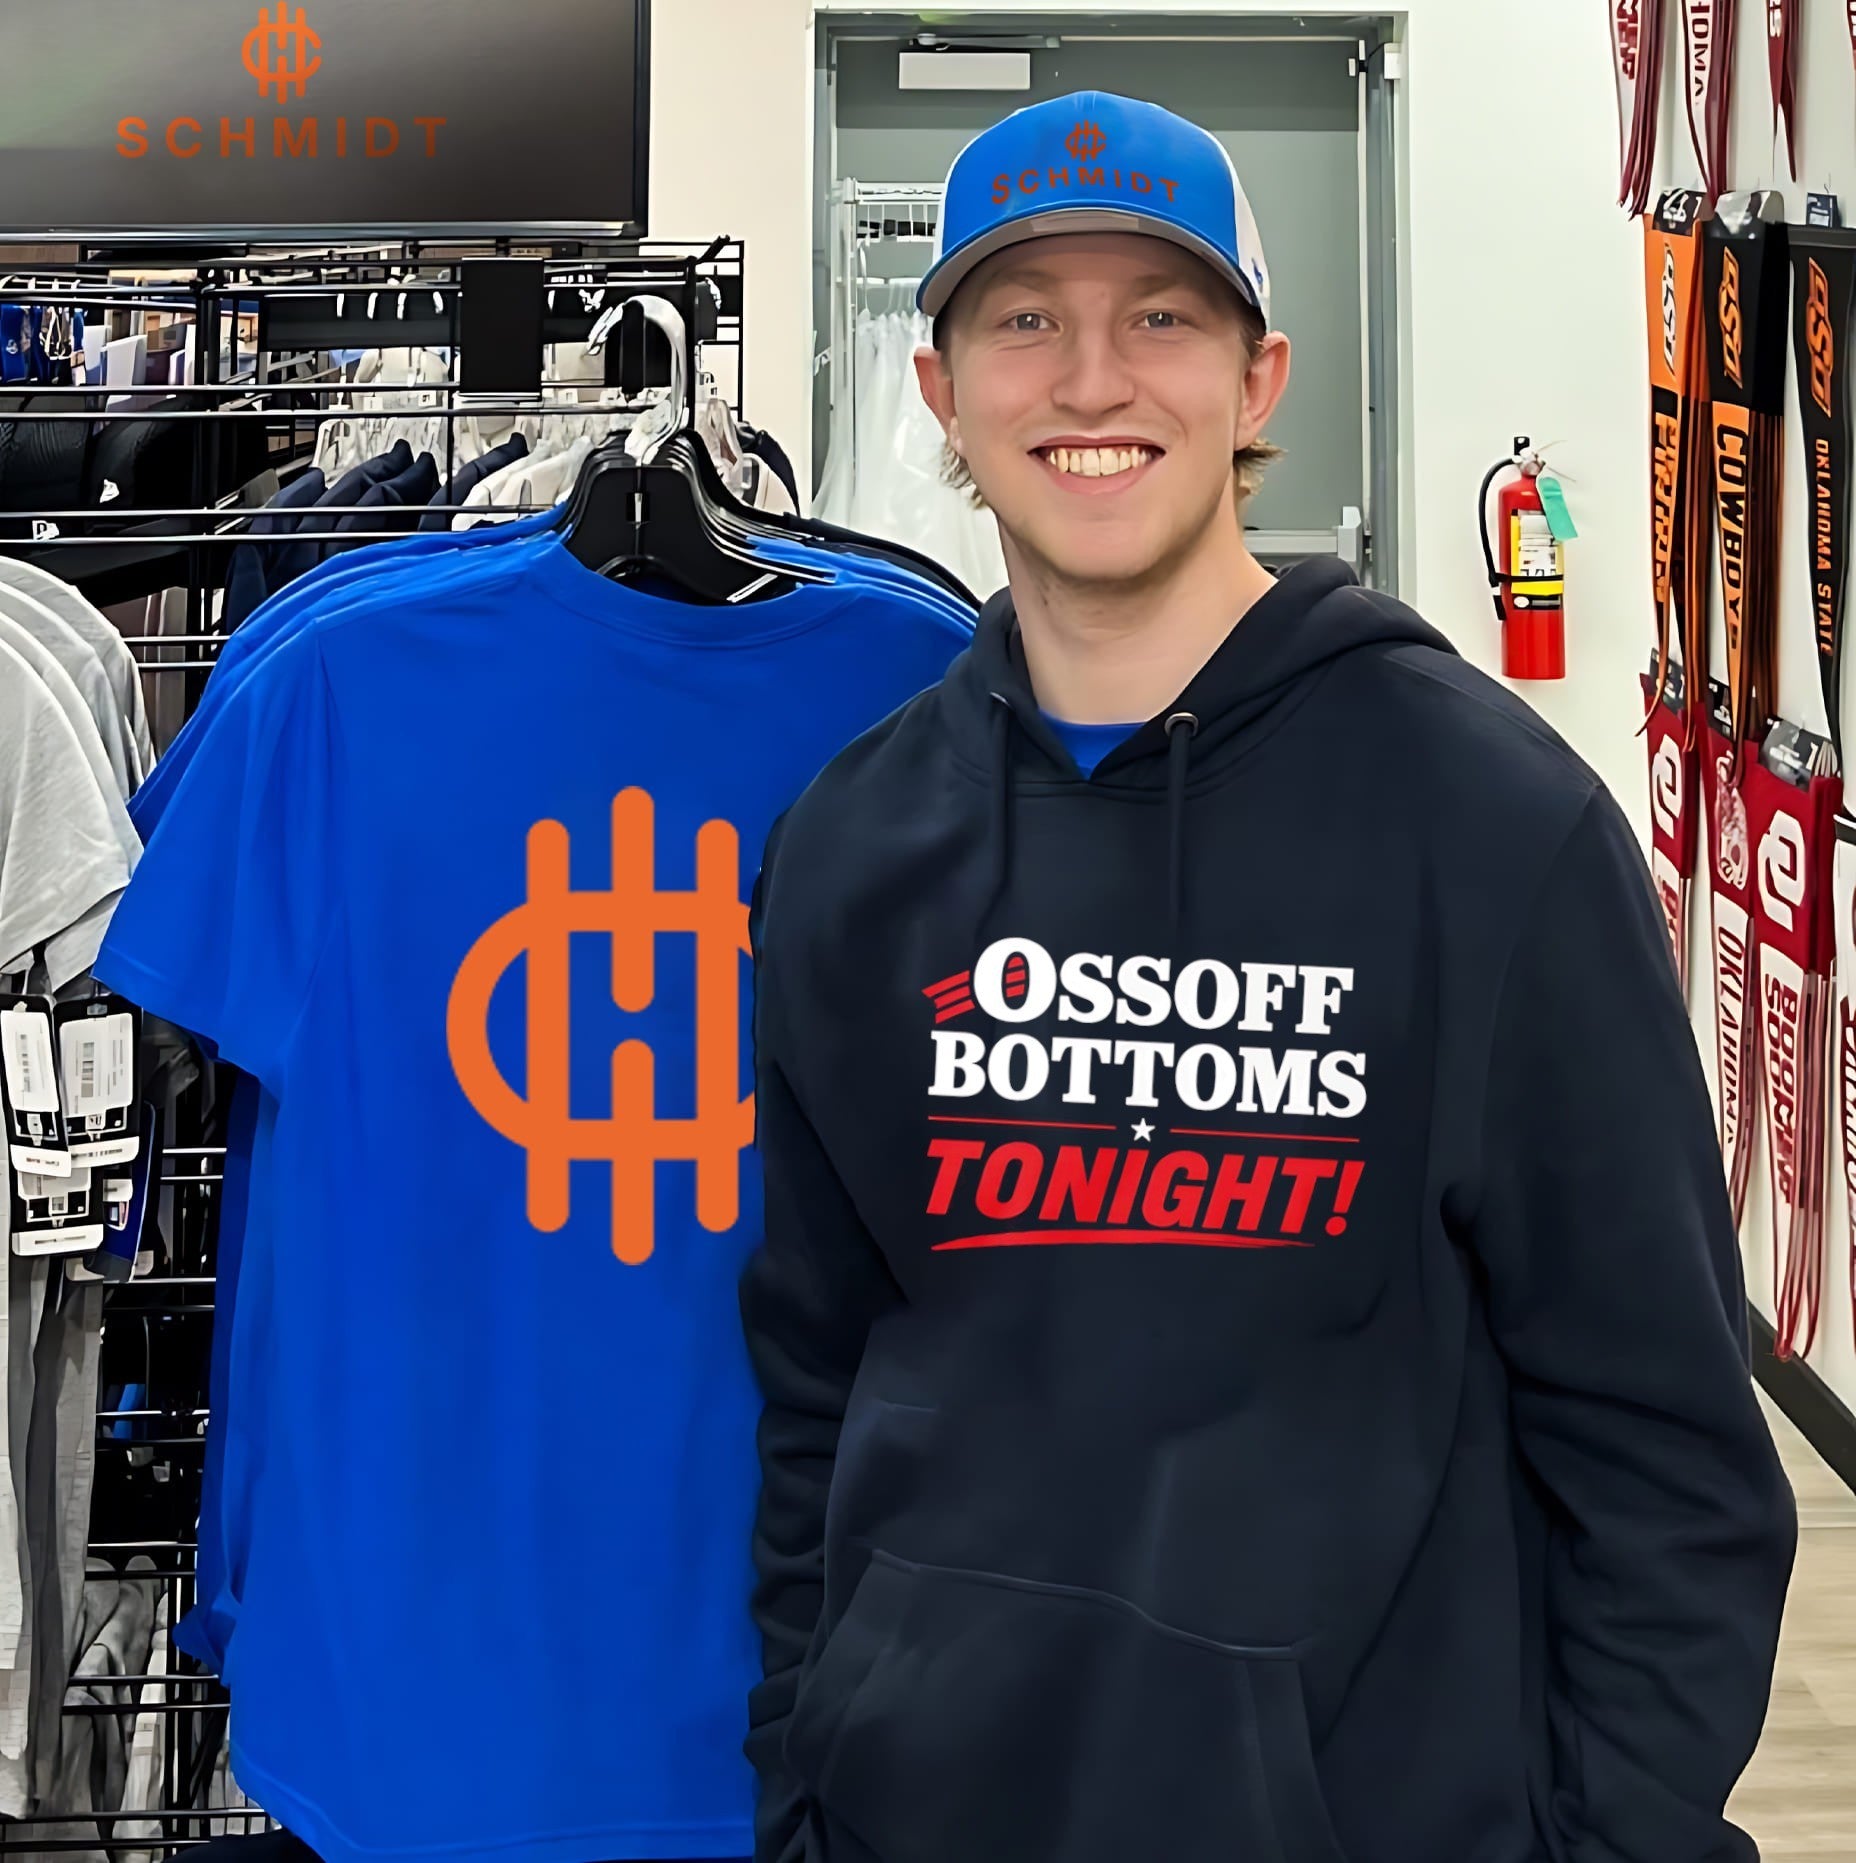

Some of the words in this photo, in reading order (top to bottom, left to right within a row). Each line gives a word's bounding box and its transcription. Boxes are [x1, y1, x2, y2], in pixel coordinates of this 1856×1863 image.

[115, 116, 448, 159] SCHMIDT
[991, 166, 1179, 205] SCHMIDT
[1816, 438, 1832, 570] OKLAHOMA
[973, 937, 1354, 1035] OSSOFF
[928, 1030, 1367, 1118] BOTTOMS
[925, 1138, 1365, 1236] TONIGHT!
